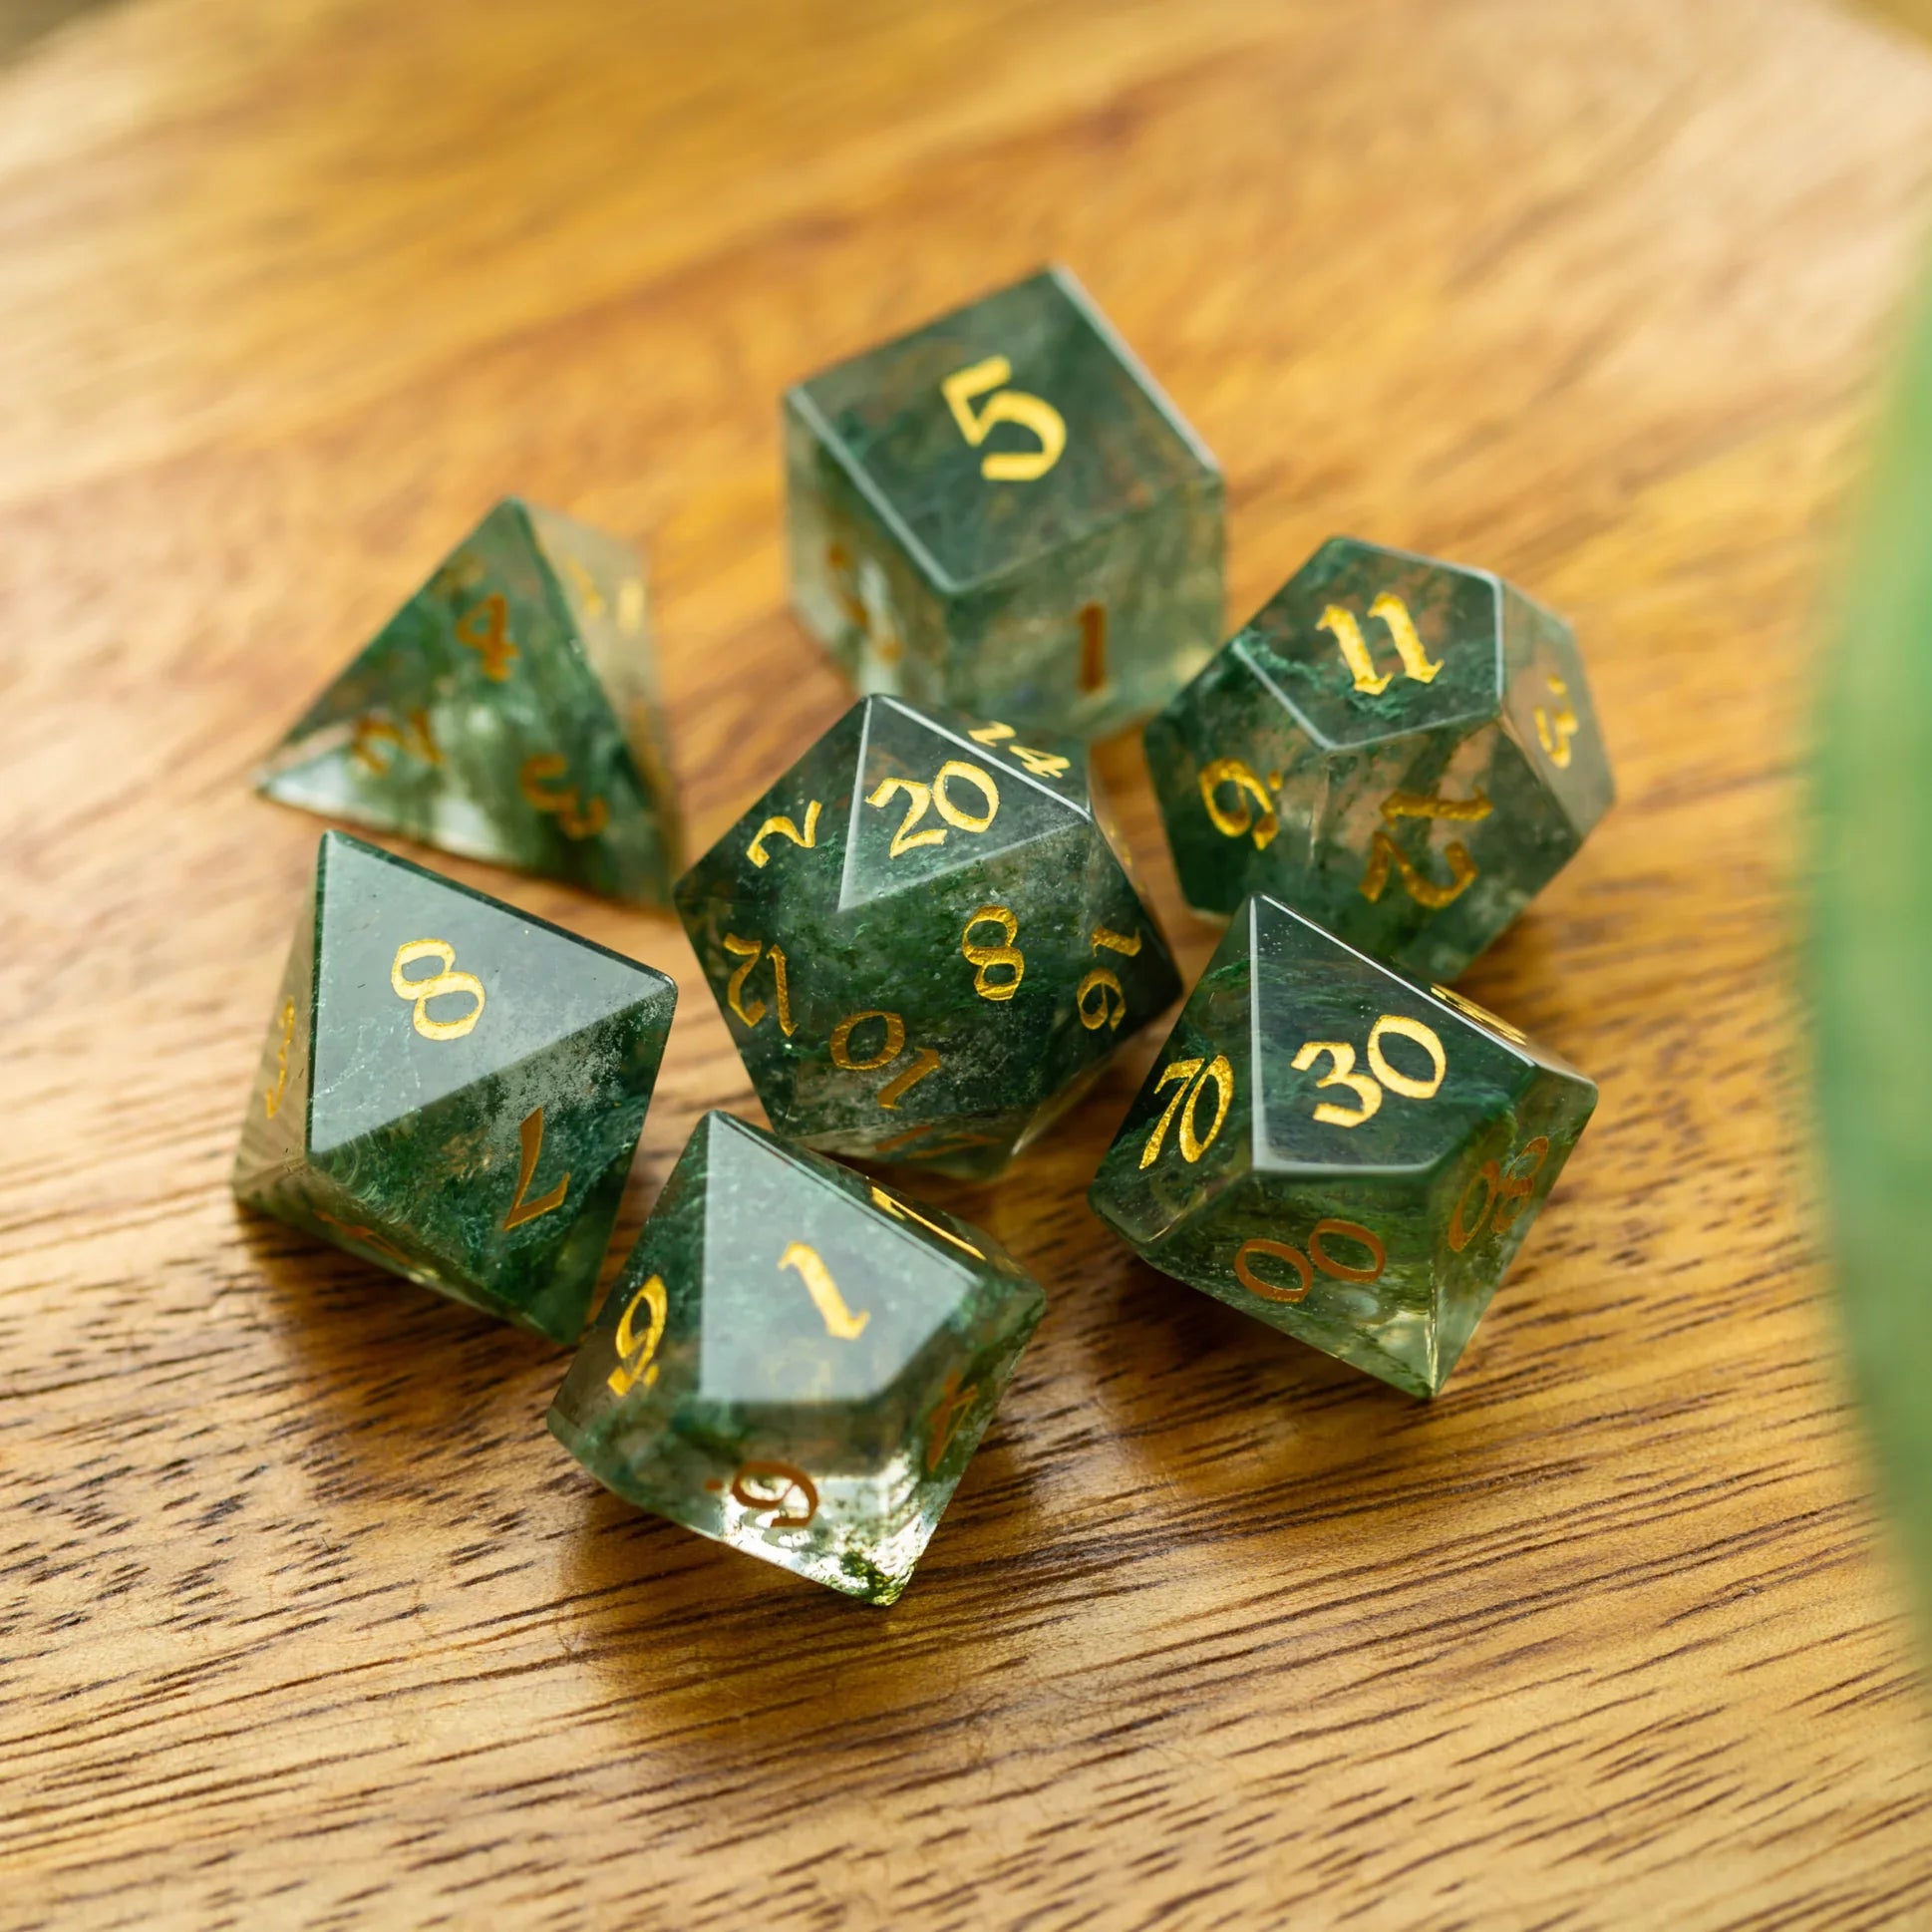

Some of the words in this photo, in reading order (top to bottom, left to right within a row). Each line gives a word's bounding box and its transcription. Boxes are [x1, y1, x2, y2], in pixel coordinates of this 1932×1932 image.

[941, 355, 1067, 482] 5
[455, 591, 519, 682] 4
[1081, 603, 1106, 691] 1
[1316, 591, 1445, 696] 11
[968, 722, 1071, 780] 14
[746, 800, 822, 869] 2
[865, 760, 1000, 858] 20
[1360, 788, 1493, 910] 12
[391, 938, 485, 1041] 8
[962, 905, 1025, 1002] 8
[1138, 1055, 1234, 1170] 70
[1290, 1014, 1447, 1128] 30
[504, 1107, 571, 1232] 7
[778, 1240, 870, 1340] 1
[1234, 1218, 1386, 1303] 00
